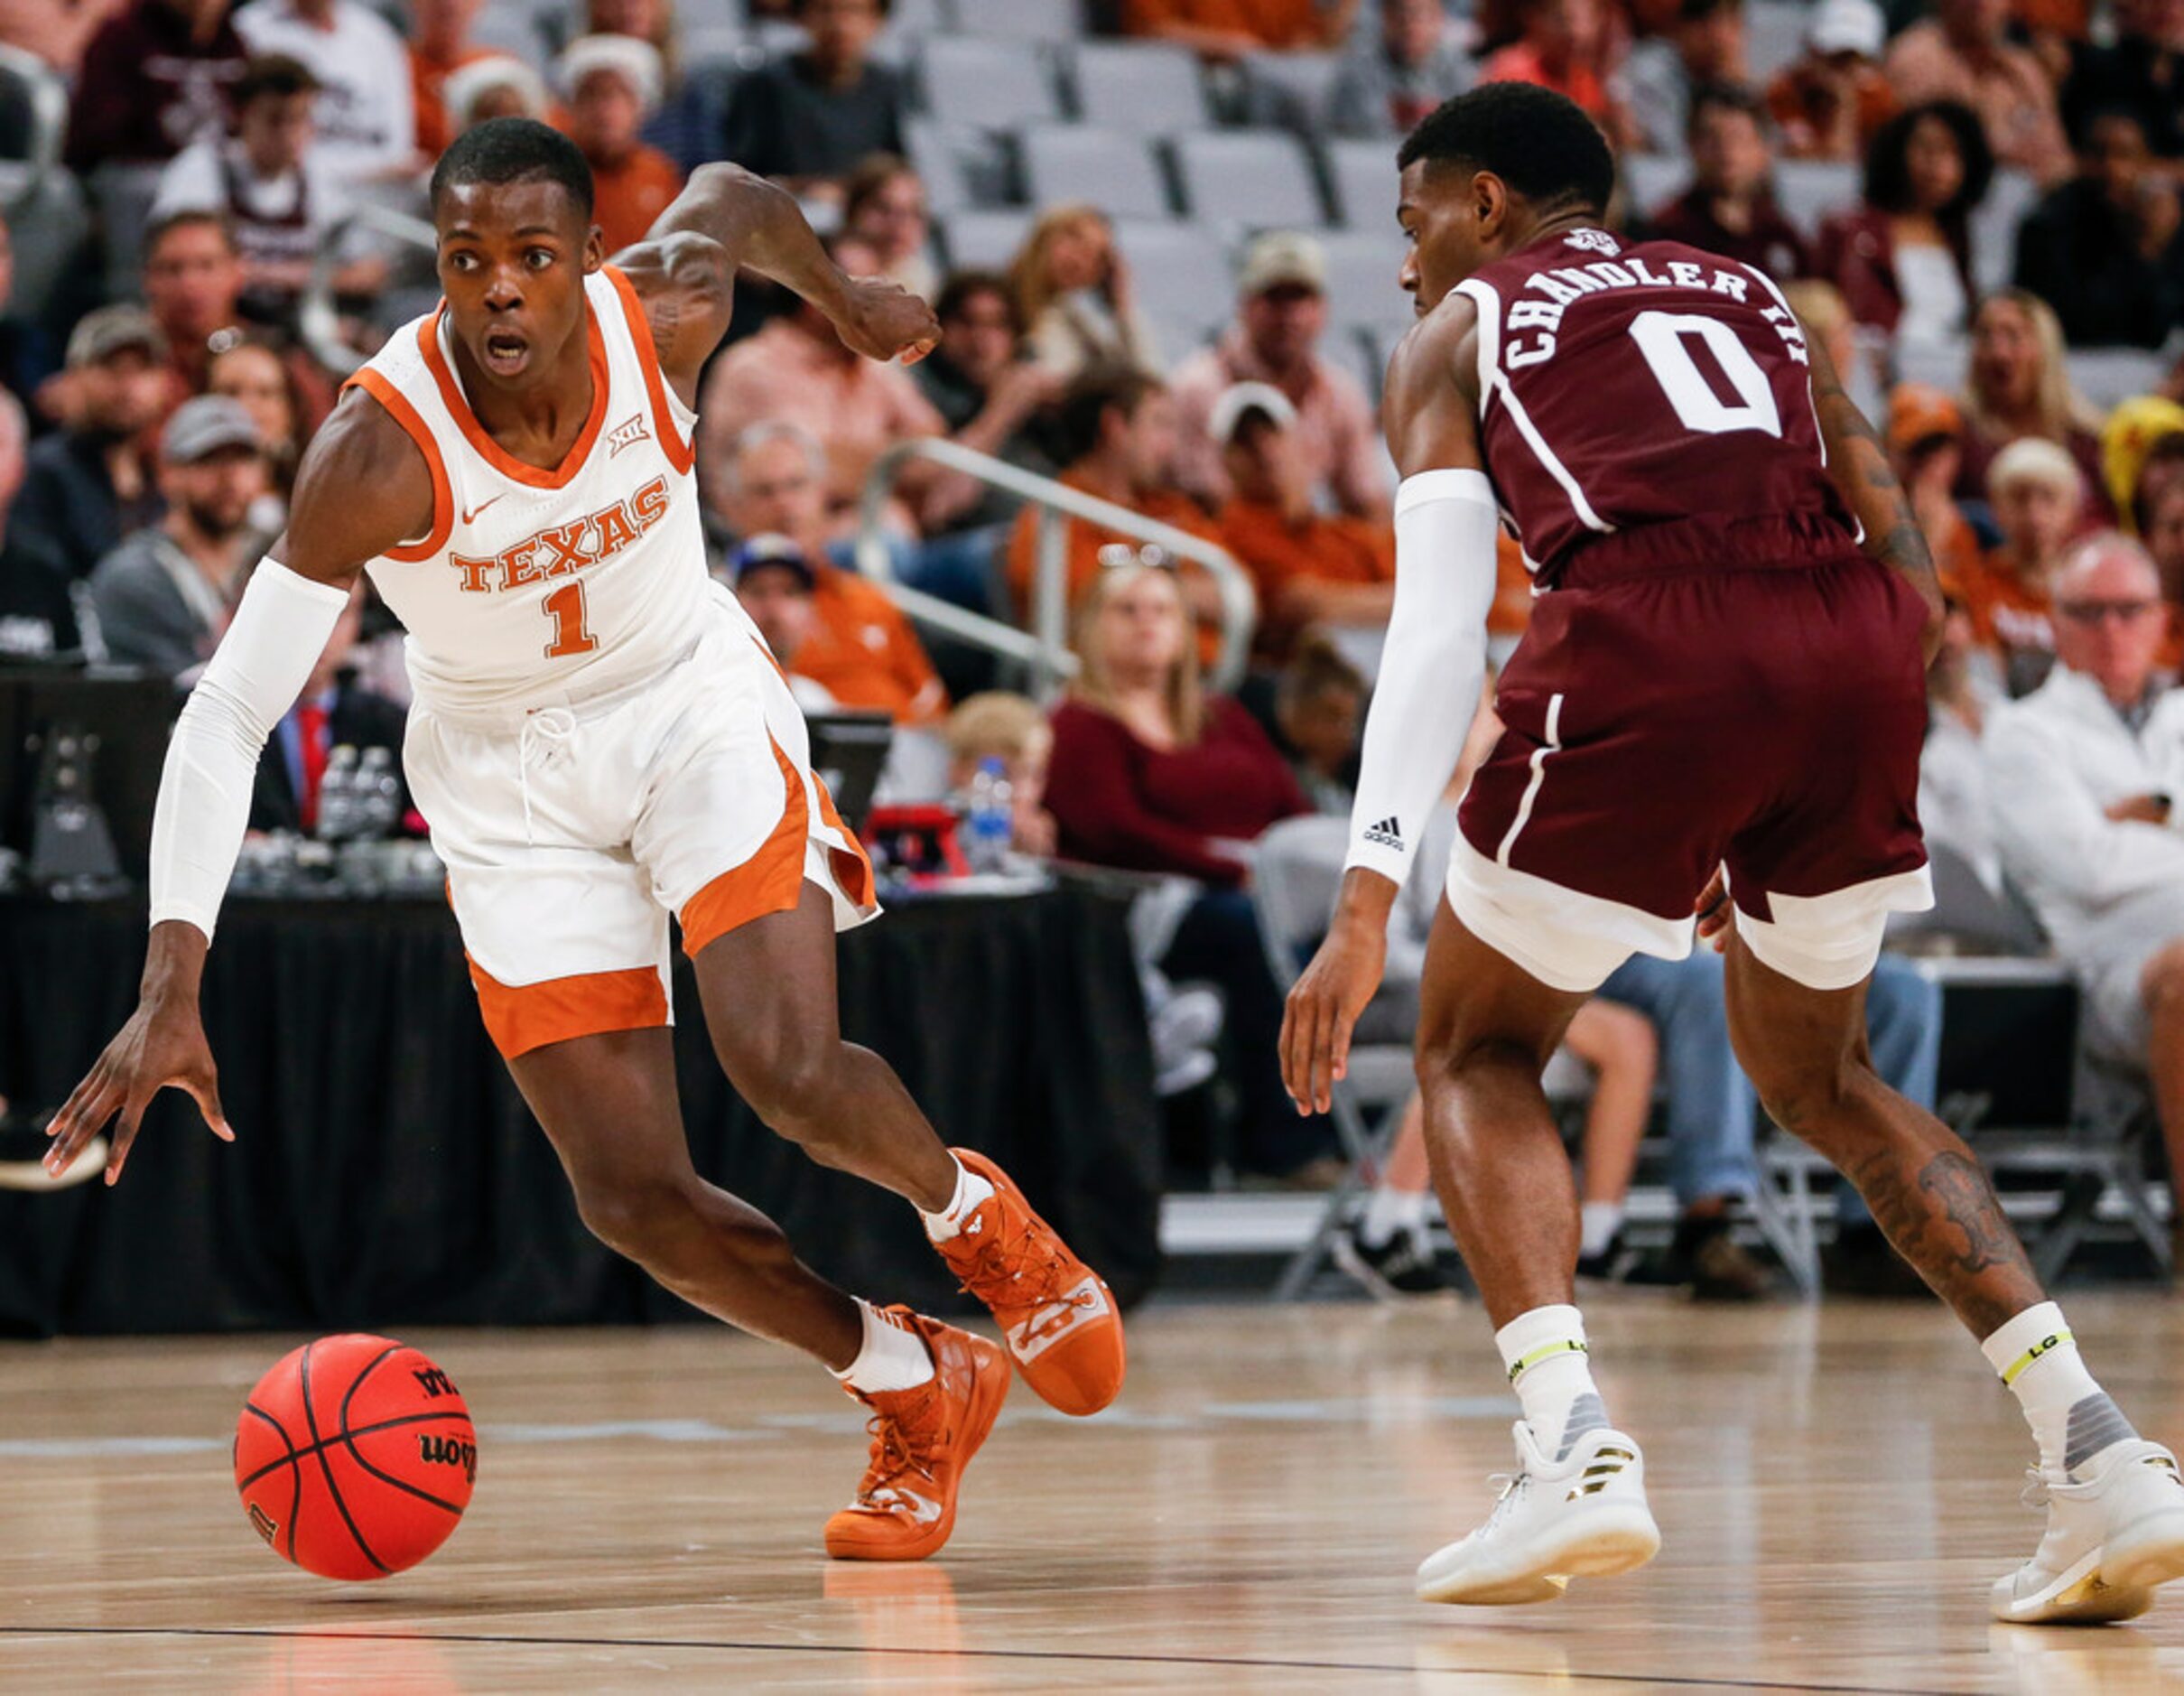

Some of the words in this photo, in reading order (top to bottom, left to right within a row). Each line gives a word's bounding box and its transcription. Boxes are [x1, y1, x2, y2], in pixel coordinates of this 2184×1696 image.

[1506, 258, 1748, 371] CHANDLER
[1629, 311, 1783, 439] 0
[450, 474, 671, 592] TEXAS
[542, 578, 599, 658] 1
[1363, 831, 1404, 852] adidas
[2028, 1335, 2059, 1358] LG
